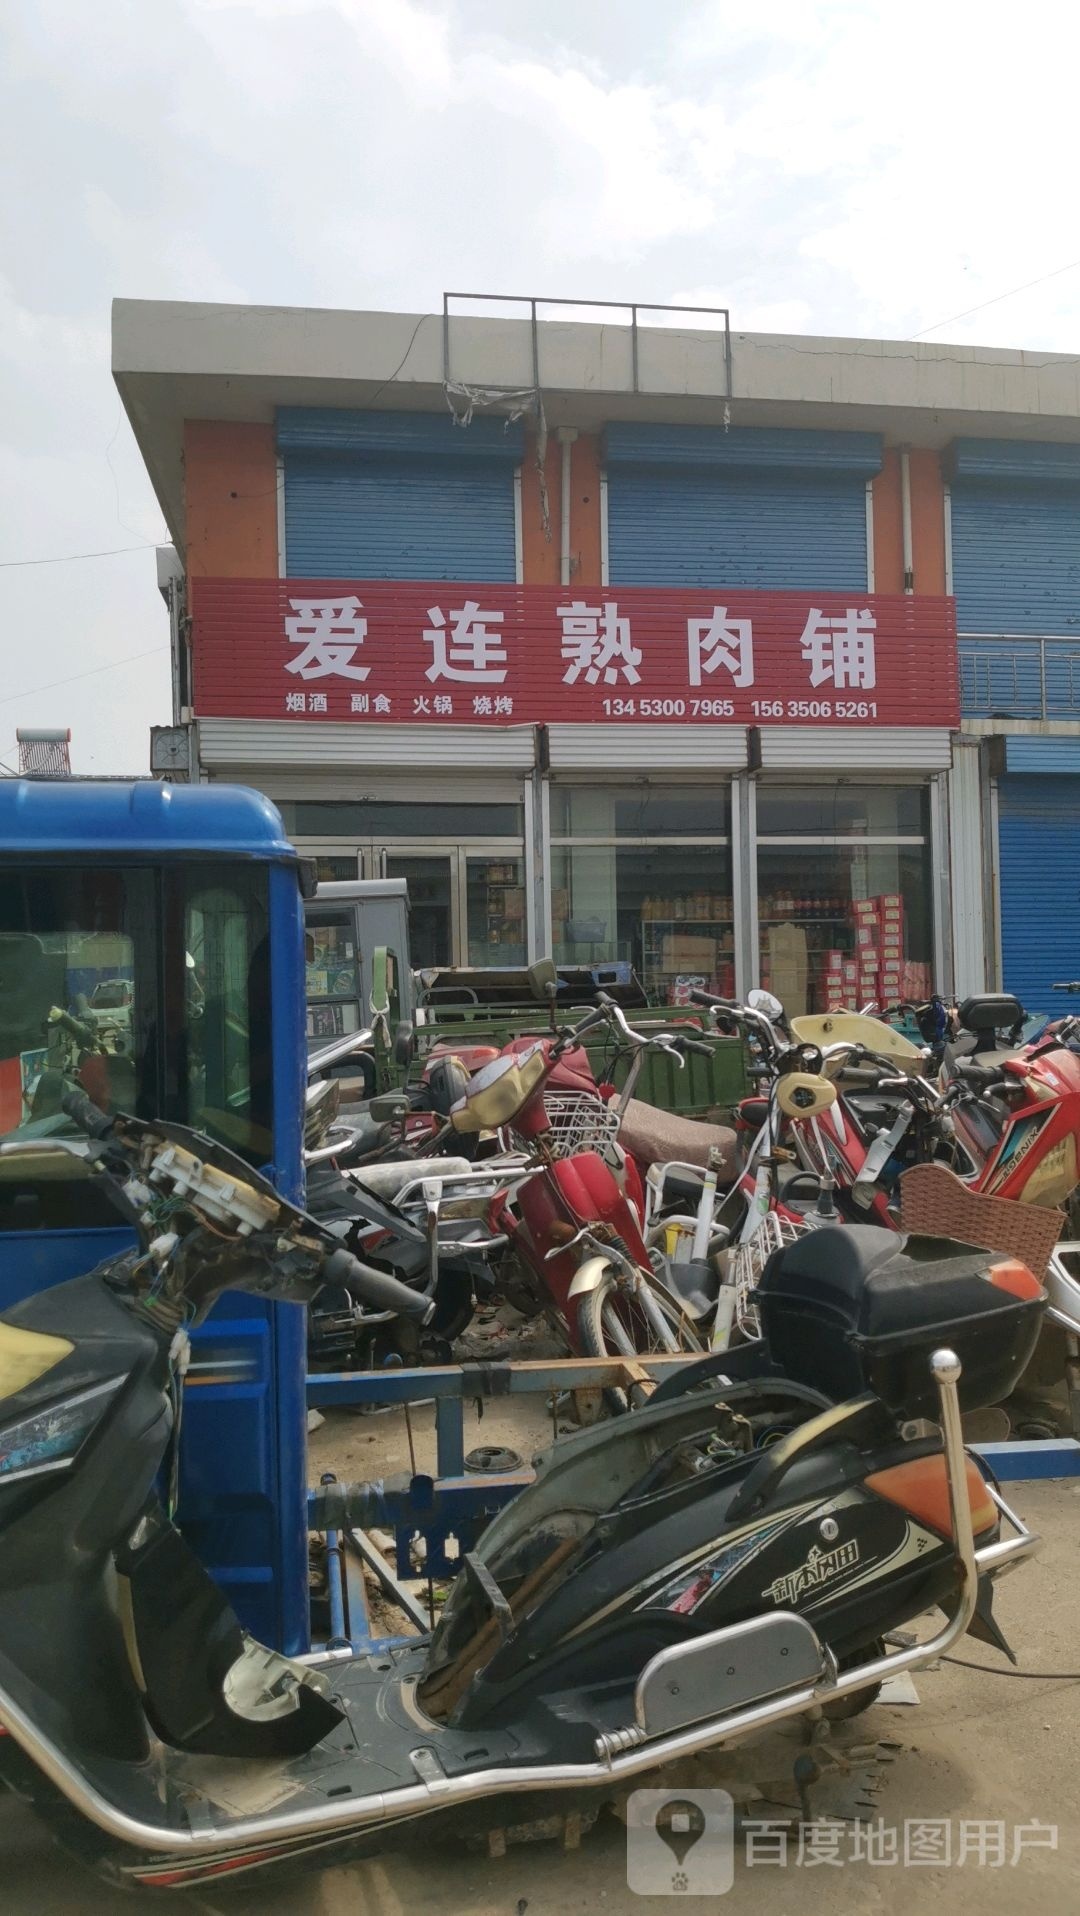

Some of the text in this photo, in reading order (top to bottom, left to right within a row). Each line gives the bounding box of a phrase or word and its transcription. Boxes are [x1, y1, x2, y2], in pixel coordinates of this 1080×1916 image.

[284, 595, 877, 689] 爱连熟肉铺
[286, 693, 514, 715] 烟酒 副食 火锅 烧烤
[603, 698, 877, 718] 134 5300 7965 156 3506 5261
